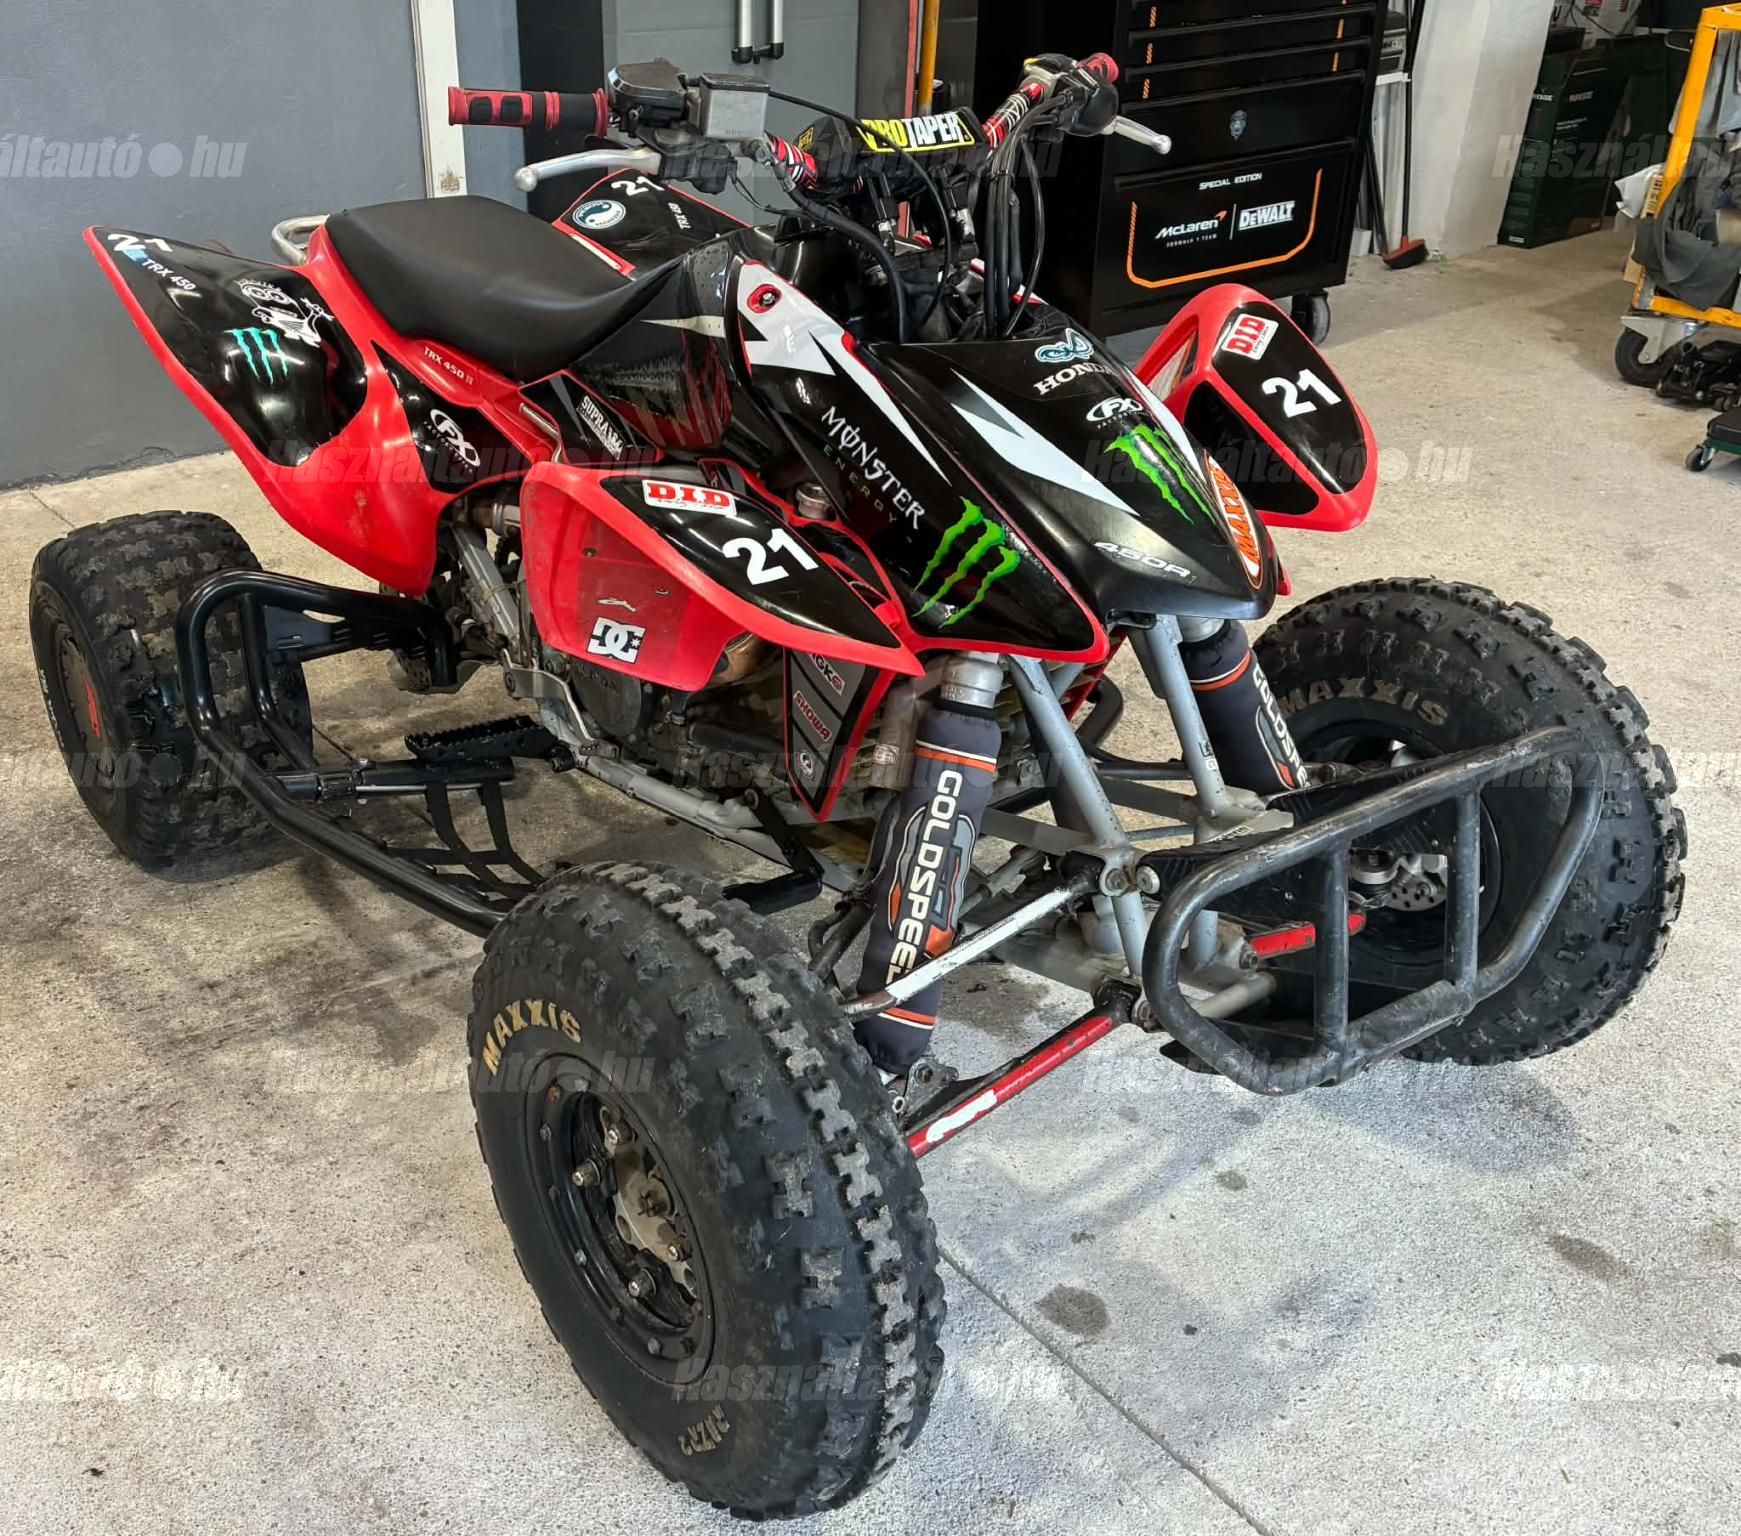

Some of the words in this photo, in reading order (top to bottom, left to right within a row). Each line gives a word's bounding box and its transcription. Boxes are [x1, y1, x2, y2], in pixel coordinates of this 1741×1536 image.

[610, 175, 666, 197] 21
[1198, 178, 1231, 190] SPECIAL
[1233, 172, 1263, 184] EDITION
[107, 233, 173, 252] 21
[1155, 218, 1220, 239] McLaren
[1166, 237, 1194, 248] FORMULA
[1201, 233, 1218, 243] TEAM
[141, 258, 174, 277] TRX
[169, 275, 197, 291] 450
[423, 346, 443, 363] TRX
[442, 361, 465, 379] 450
[1033, 362, 1121, 396] HONDA
[1092, 396, 1143, 421] FX
[1261, 368, 1342, 418] 21
[433, 411, 478, 464] FX
[822, 445, 898, 524] ENERGY
[1208, 466, 1261, 565] MAXXIS
[722, 528, 820, 586] 21
[1093, 541, 1193, 578] 450R
[793, 691, 832, 741] SHOWA
[1279, 677, 1449, 726] MAXXIS
[1252, 662, 1310, 790] GOLDSPE
[482, 997, 583, 1077] MAXXIS
